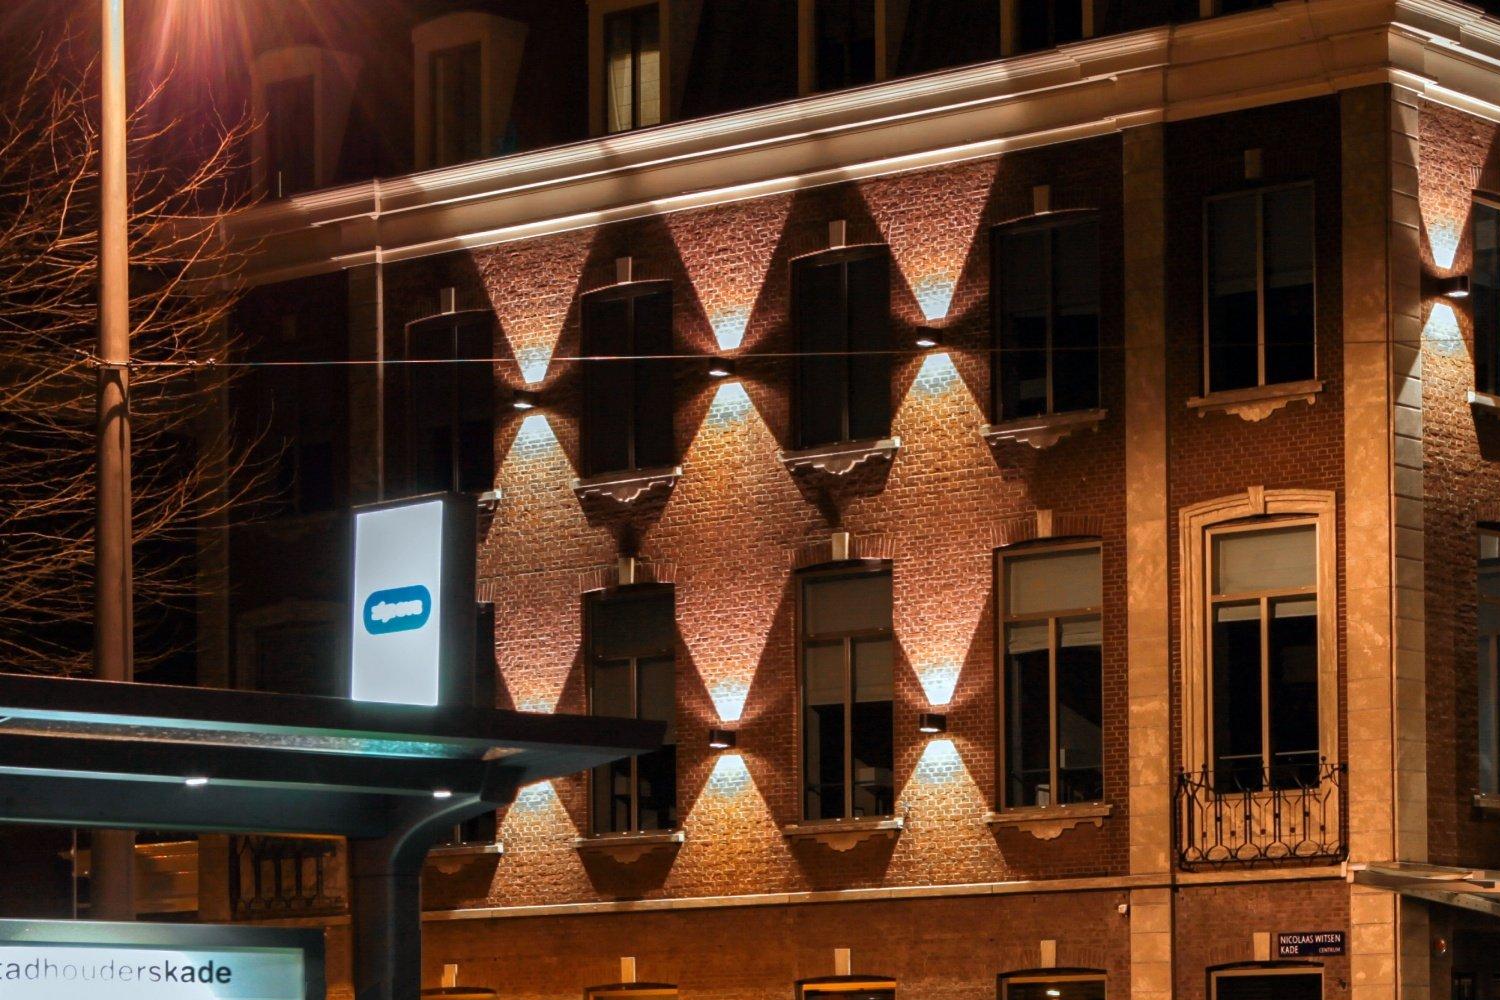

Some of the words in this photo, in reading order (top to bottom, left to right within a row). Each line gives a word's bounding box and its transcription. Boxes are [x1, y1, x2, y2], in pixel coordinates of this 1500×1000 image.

[1280, 935, 1313, 944] NICOLAAS
[1315, 934, 1341, 943] WITSEN
[1280, 945, 1299, 954] KADE
[0, 957, 232, 984] adhouderskade
